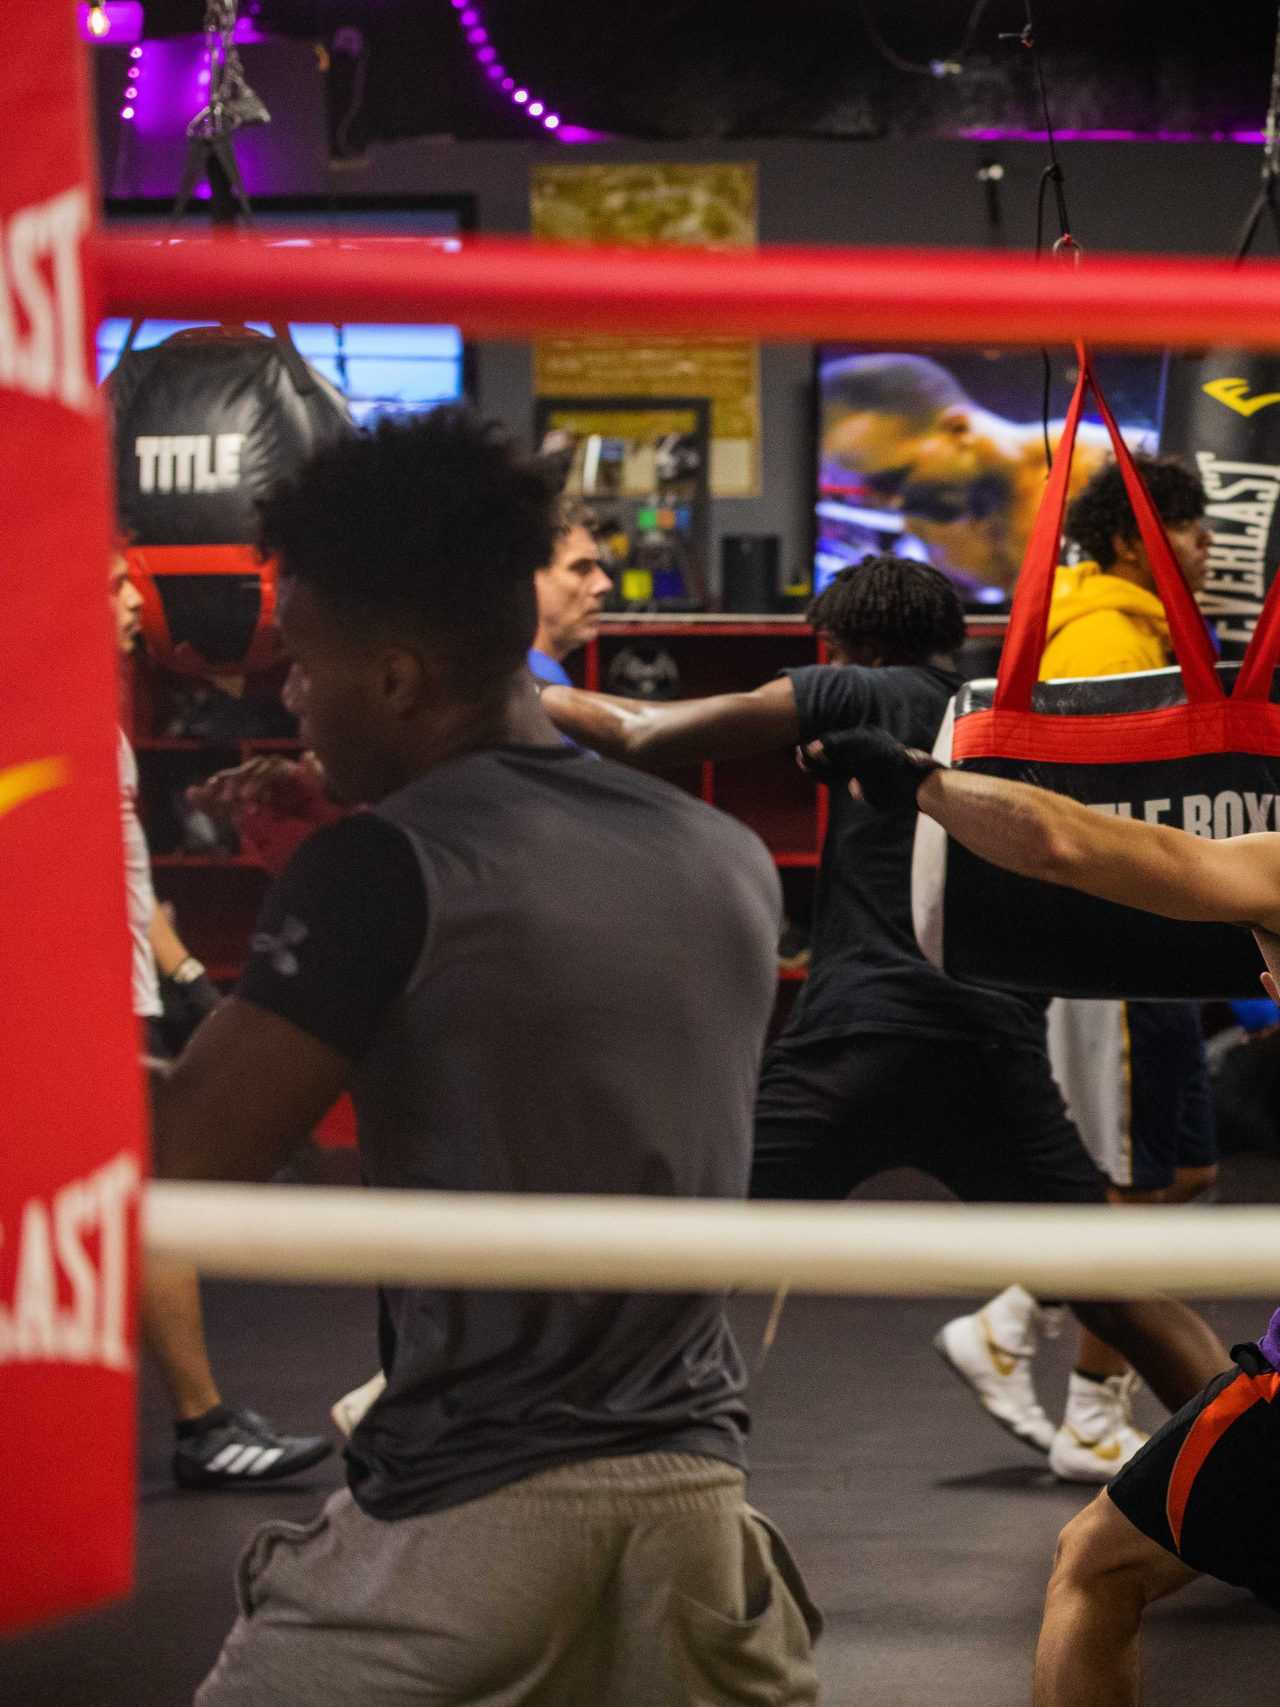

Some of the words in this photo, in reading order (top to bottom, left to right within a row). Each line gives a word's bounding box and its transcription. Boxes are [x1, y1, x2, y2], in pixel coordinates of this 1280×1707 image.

[0, 188, 98, 412] ST
[135, 433, 244, 493] TITLE
[0, 1152, 140, 1370] AST
